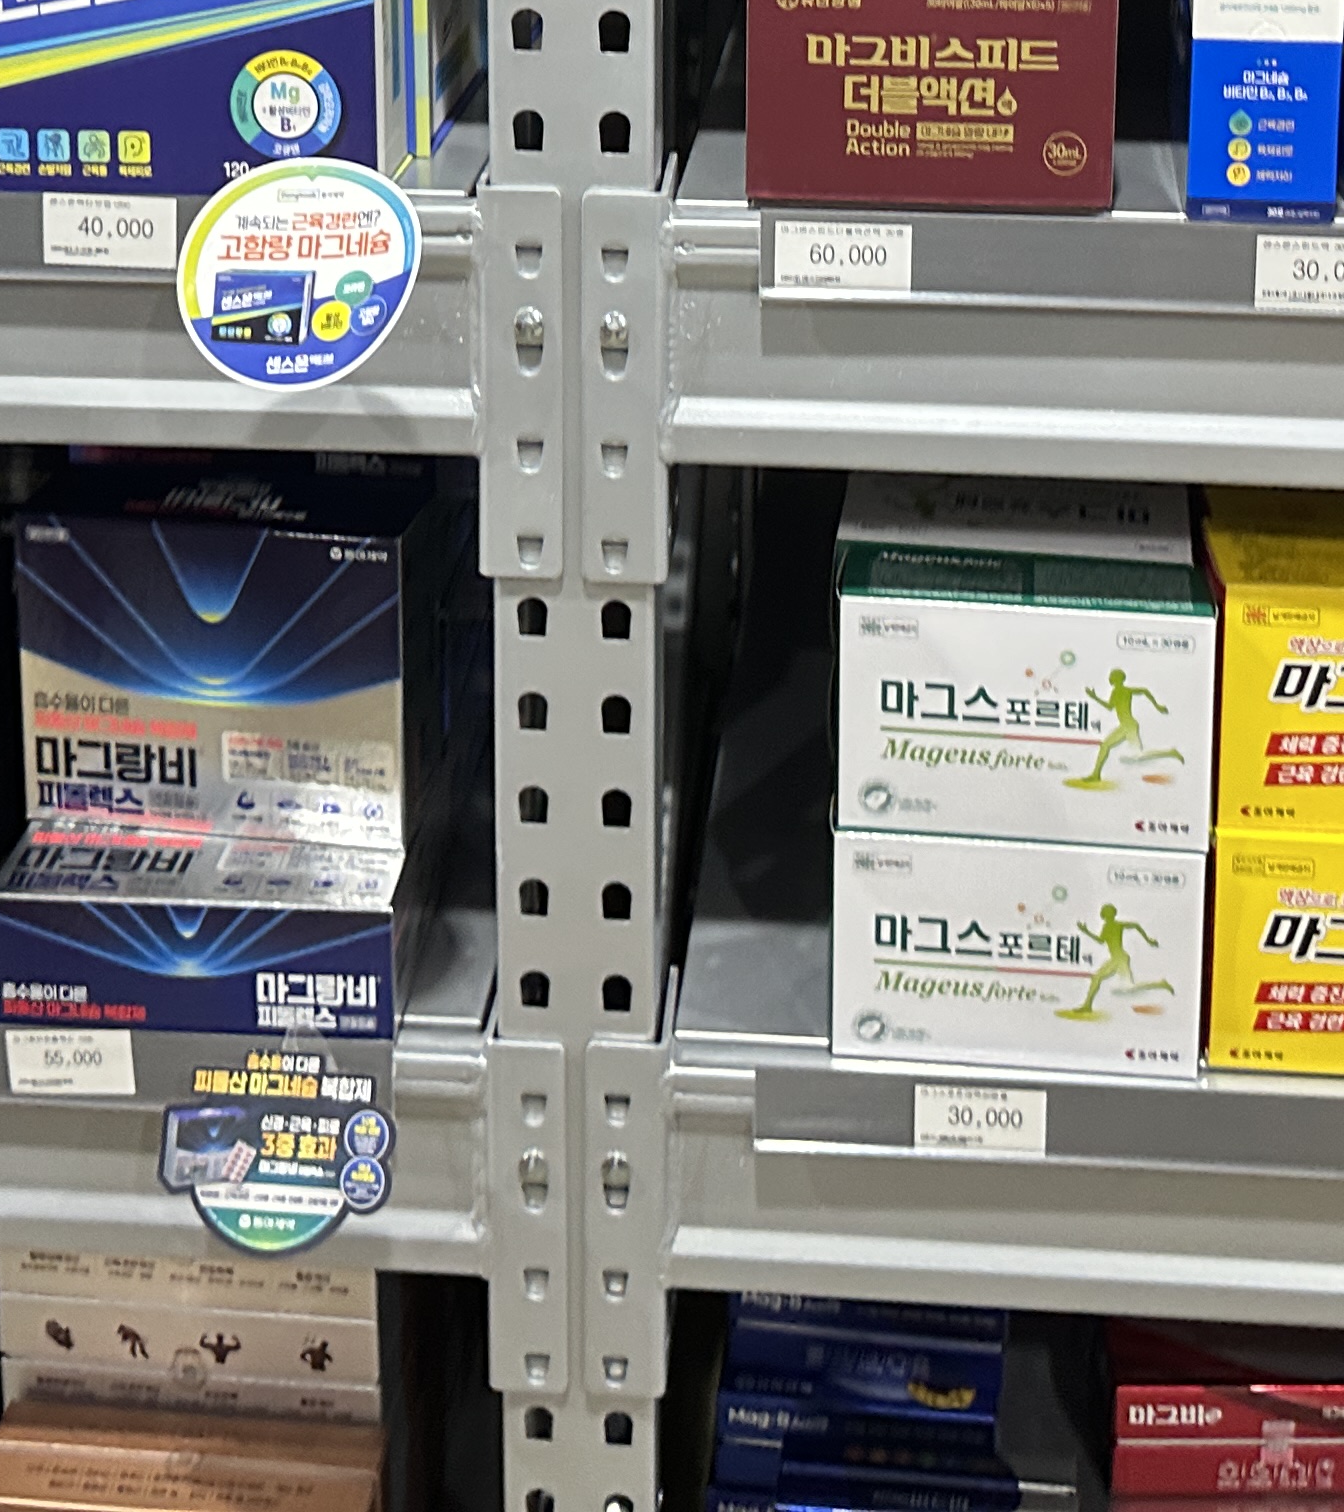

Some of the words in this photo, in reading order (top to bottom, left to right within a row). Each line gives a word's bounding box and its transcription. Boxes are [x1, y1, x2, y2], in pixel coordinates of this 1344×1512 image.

[804, 33, 1061, 73] 마그비스피드
[270, 80, 302, 107] Mg
[843, 73, 996, 118] 더블액션
[846, 118, 912, 139] Double
[845, 139, 911, 159] Action
[77, 216, 155, 240] 40,000
[235, 213, 289, 232] 계속되는
[217, 232, 293, 262] 고함량
[299, 228, 392, 261] 마그네슘
[809, 241, 888, 269] 60,000
[879, 677, 1003, 722] 마그스
[1005, 699, 1091, 732] 포르테
[34, 735, 198, 788] 마그랑비
[881, 736, 993, 774] Mageus
[992, 746, 1047, 773] forte
[873, 913, 994, 957] 마그스
[996, 934, 1082, 966] 포르테
[875, 968, 984, 1007] Mageus
[983, 979, 1039, 1005] forte
[947, 1104, 1025, 1131] 30,000
